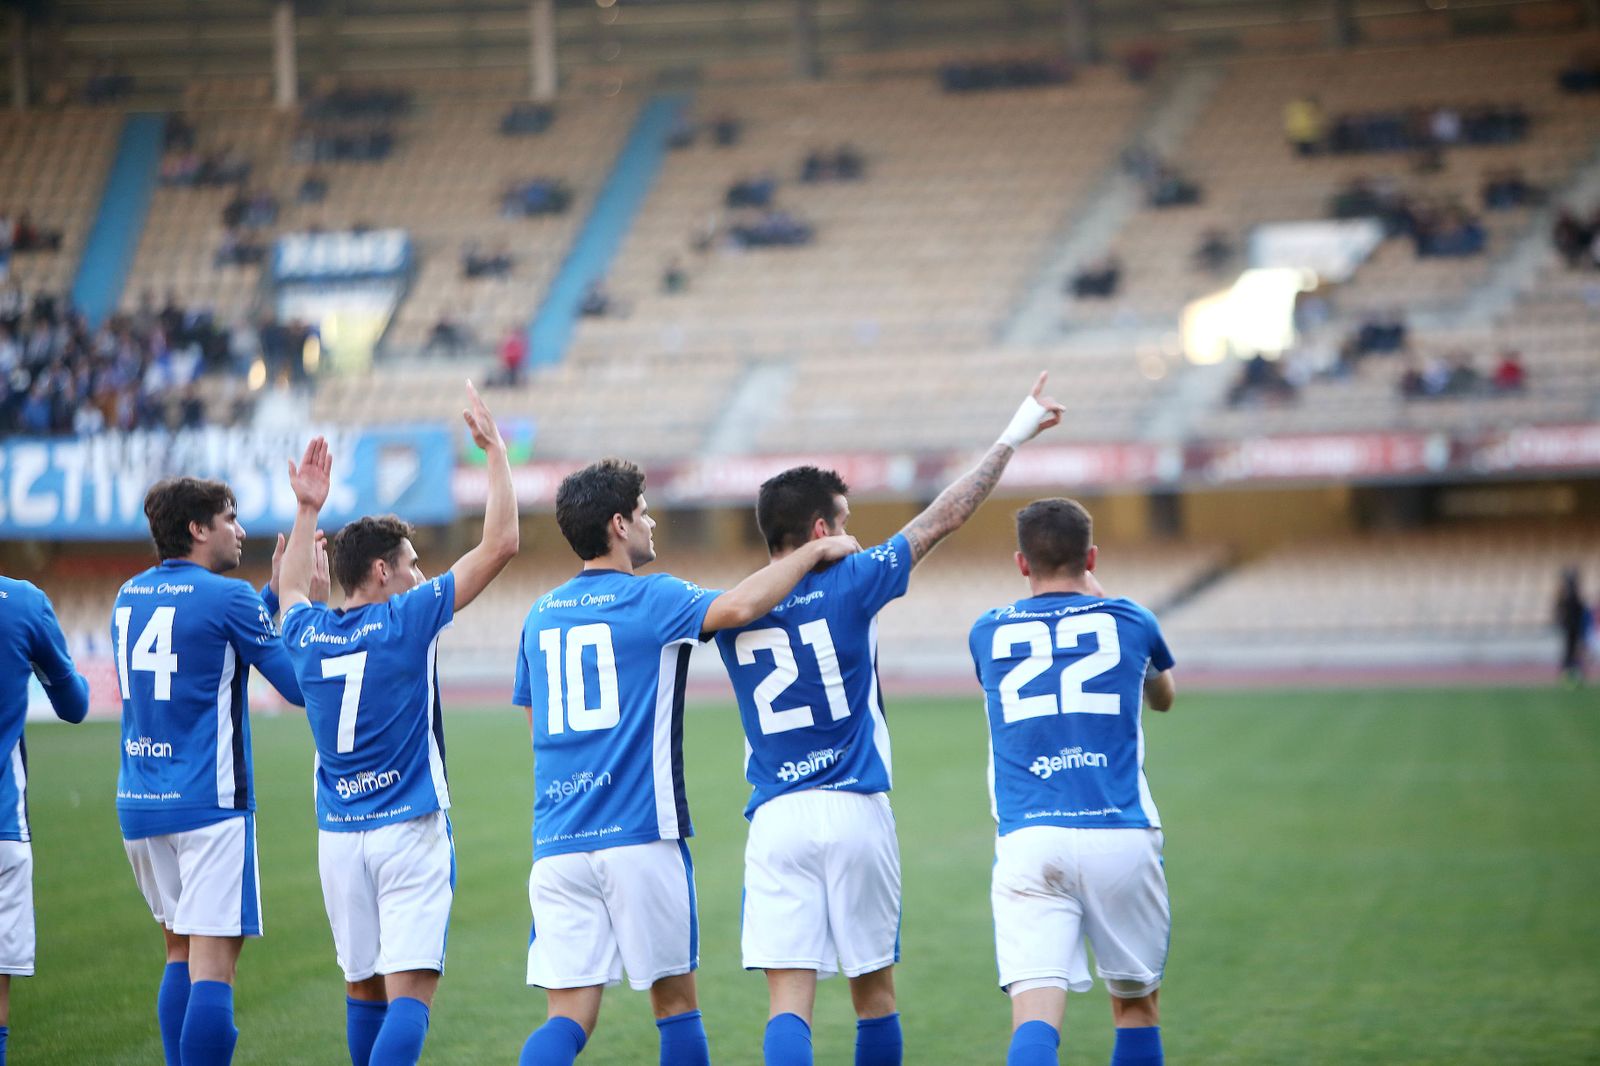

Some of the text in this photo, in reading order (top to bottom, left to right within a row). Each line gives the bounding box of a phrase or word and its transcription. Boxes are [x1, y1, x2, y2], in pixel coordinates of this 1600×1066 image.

[114, 606, 178, 701] 14
[320, 650, 368, 755] 7
[538, 622, 621, 736] 10
[735, 617, 852, 736] 21
[992, 612, 1121, 724] 22
[1029, 752, 1108, 779] Beiman
